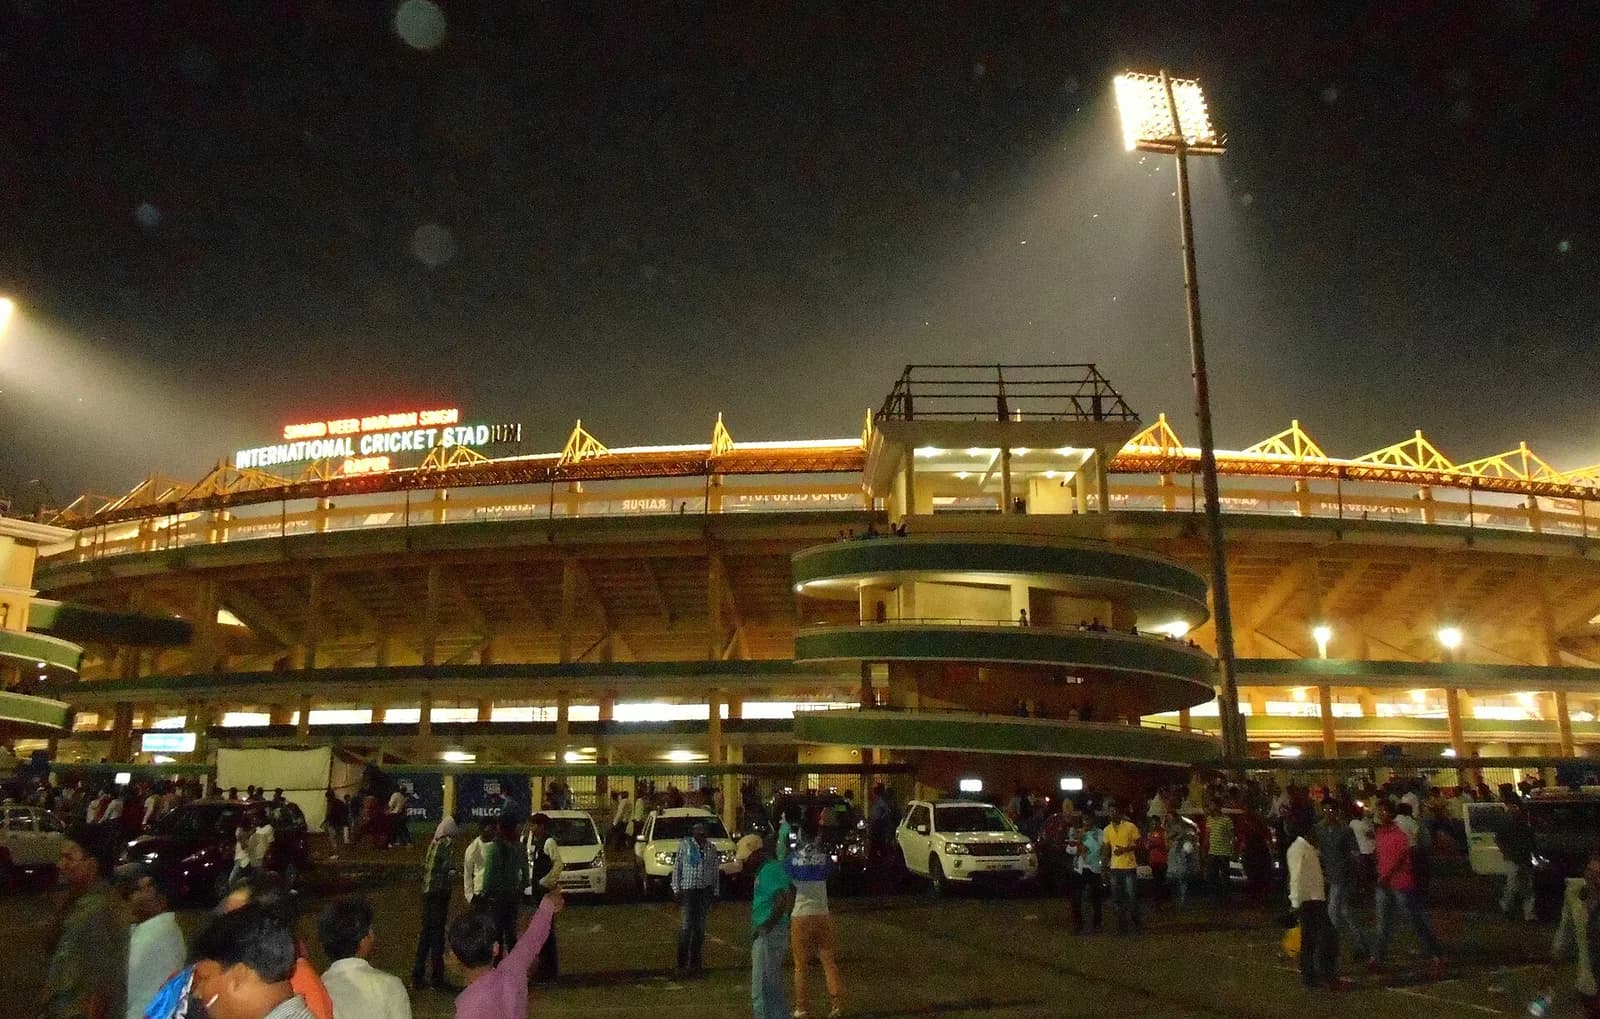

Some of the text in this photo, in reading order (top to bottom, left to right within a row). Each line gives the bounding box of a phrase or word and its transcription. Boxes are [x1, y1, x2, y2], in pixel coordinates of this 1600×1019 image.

[236, 436, 355, 471] INTERNATIONAL
[360, 428, 438, 455] CRICKET
[471, 807, 501, 817] WELCO
